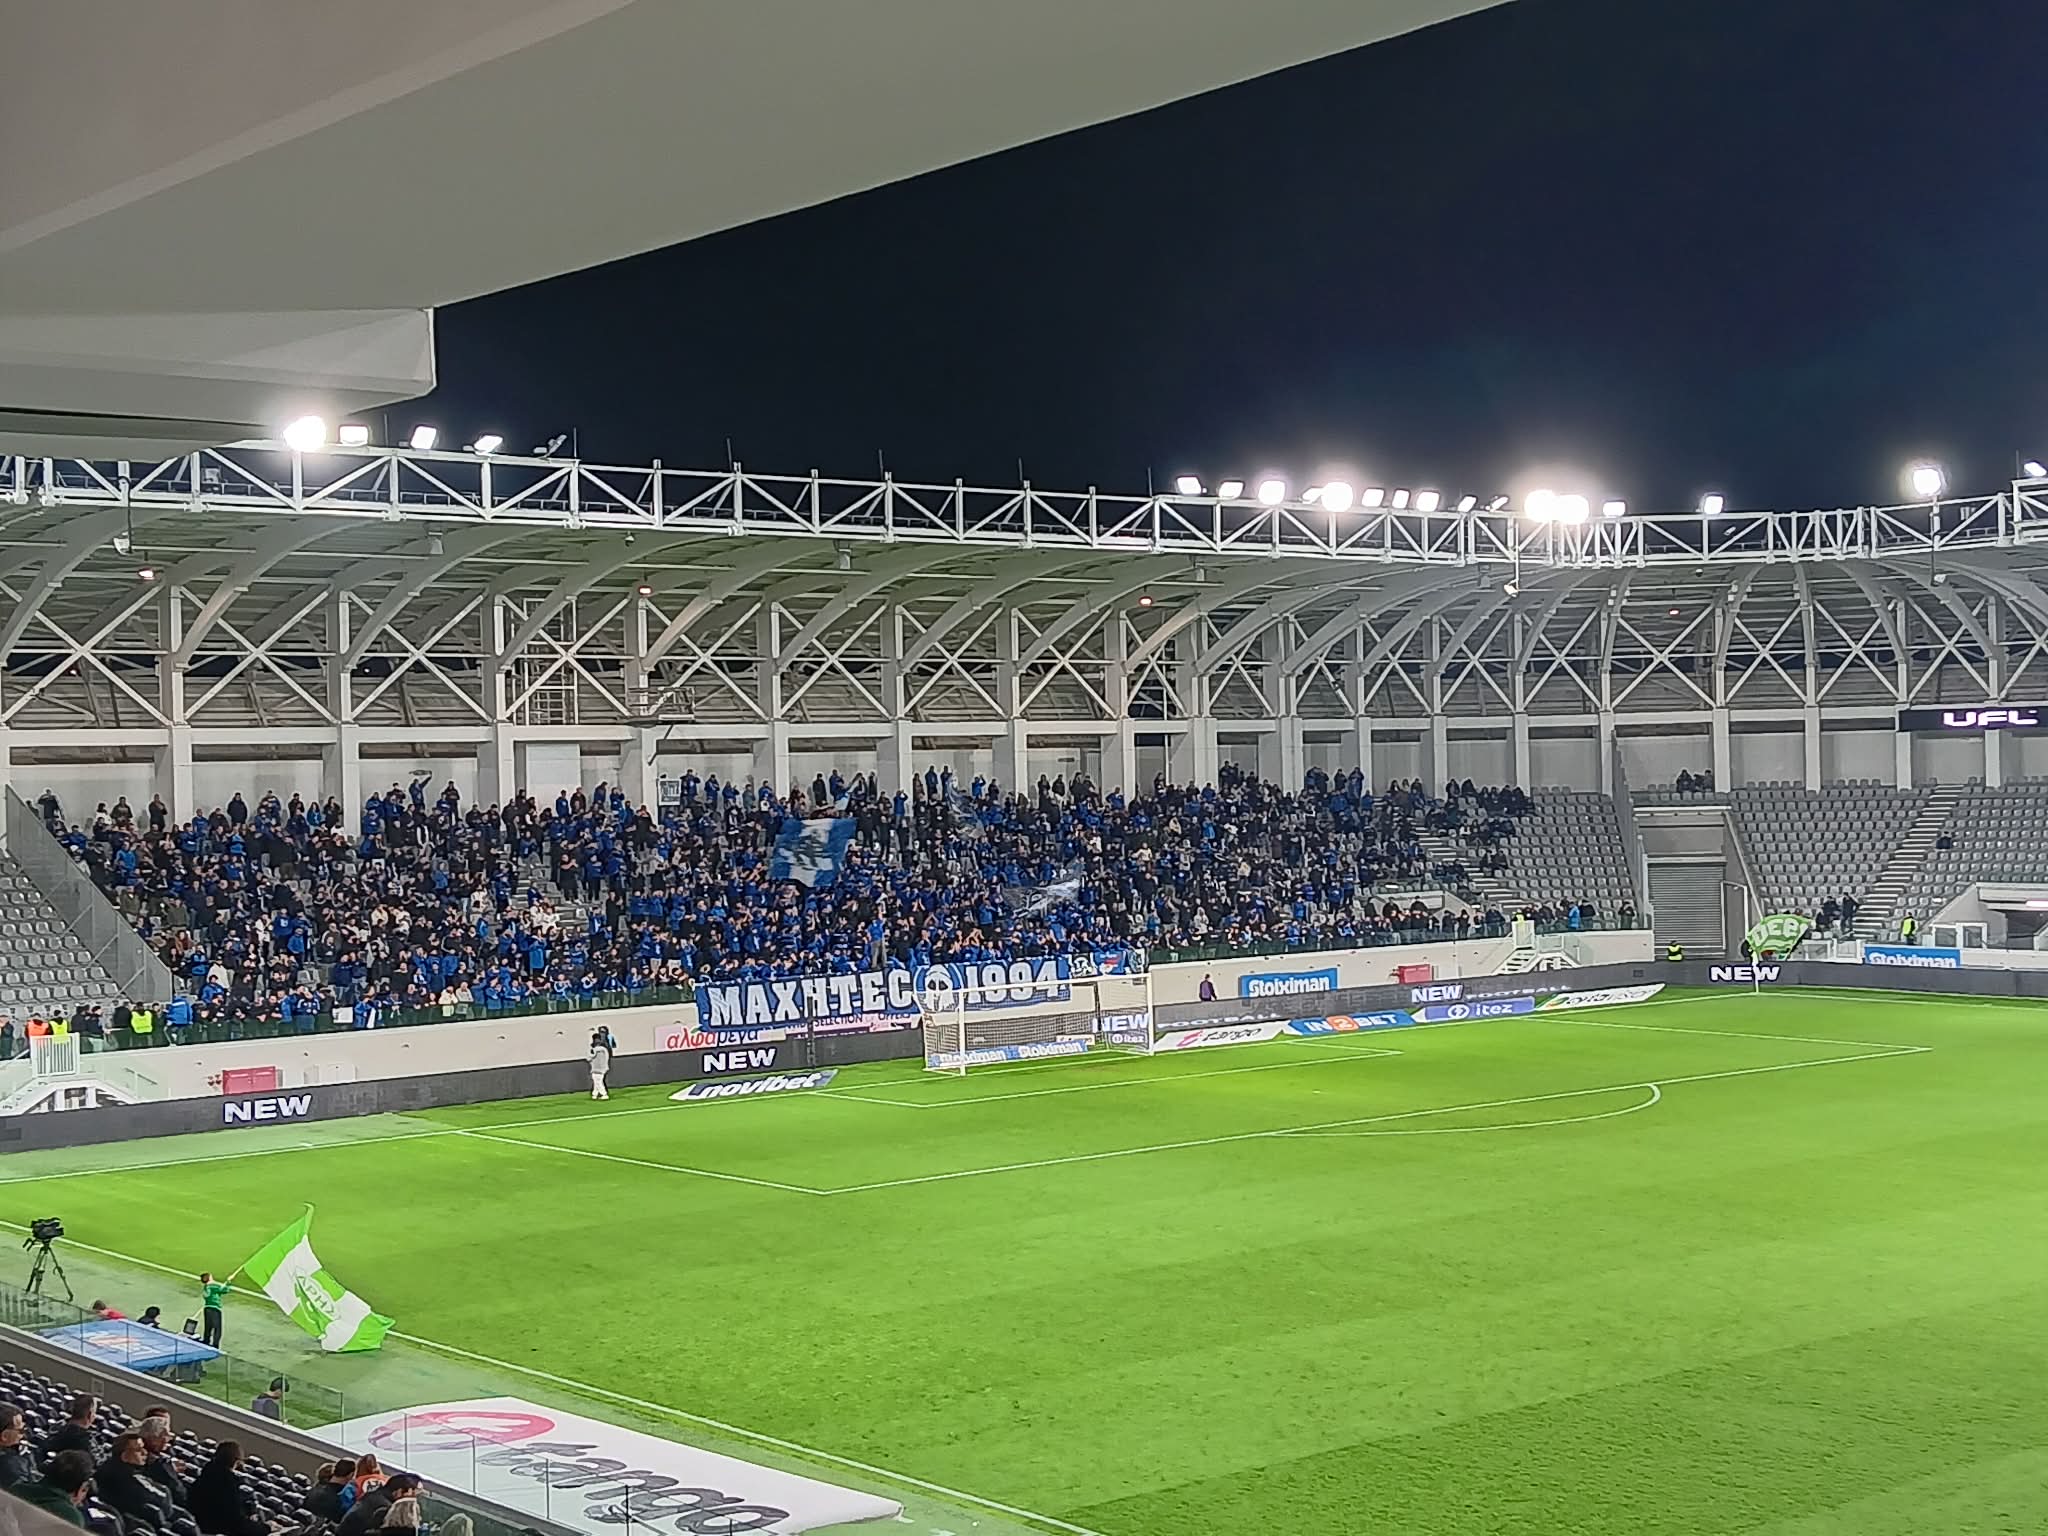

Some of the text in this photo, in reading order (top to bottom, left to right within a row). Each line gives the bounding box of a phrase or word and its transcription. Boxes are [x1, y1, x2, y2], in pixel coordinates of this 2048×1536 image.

[1943, 711, 2039, 726] UFL
[966, 960, 1065, 1004] 1994
[1711, 966, 1780, 981] NEW
[1249, 976, 1330, 998] Stoiximan
[1411, 985, 1463, 1003] NEW
[1475, 1003, 1513, 1016] itez
[1092, 1013, 1149, 1033] NEW
[1304, 1014, 1397, 1032] IN2BET
[703, 1048, 776, 1072] NEW
[699, 1071, 823, 1099] novibet
[224, 1094, 312, 1123] NEW
